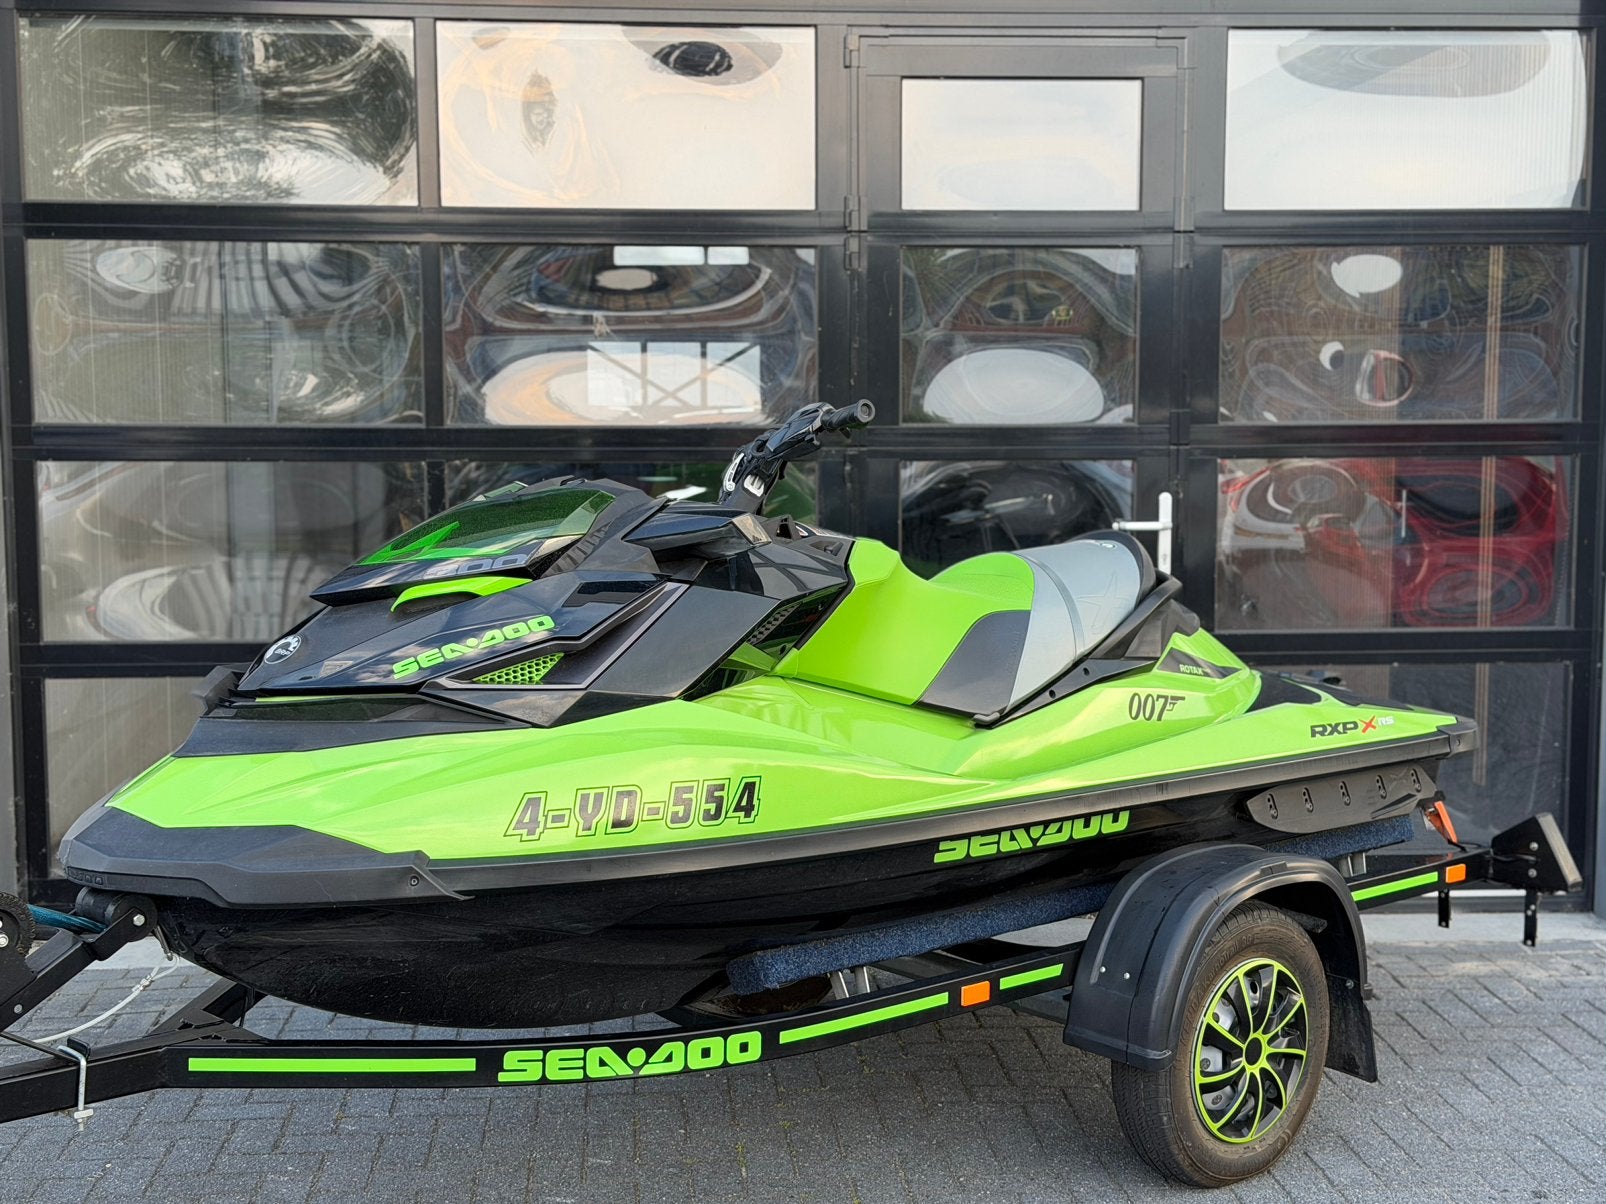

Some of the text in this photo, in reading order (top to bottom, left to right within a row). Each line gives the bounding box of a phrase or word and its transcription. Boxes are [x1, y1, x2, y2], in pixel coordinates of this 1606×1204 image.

[1179, 664, 1204, 676] ROTAX
[1128, 692, 1170, 722] 007
[1310, 721, 1359, 738] RXP
[503, 775, 762, 842] 4-YD-554
